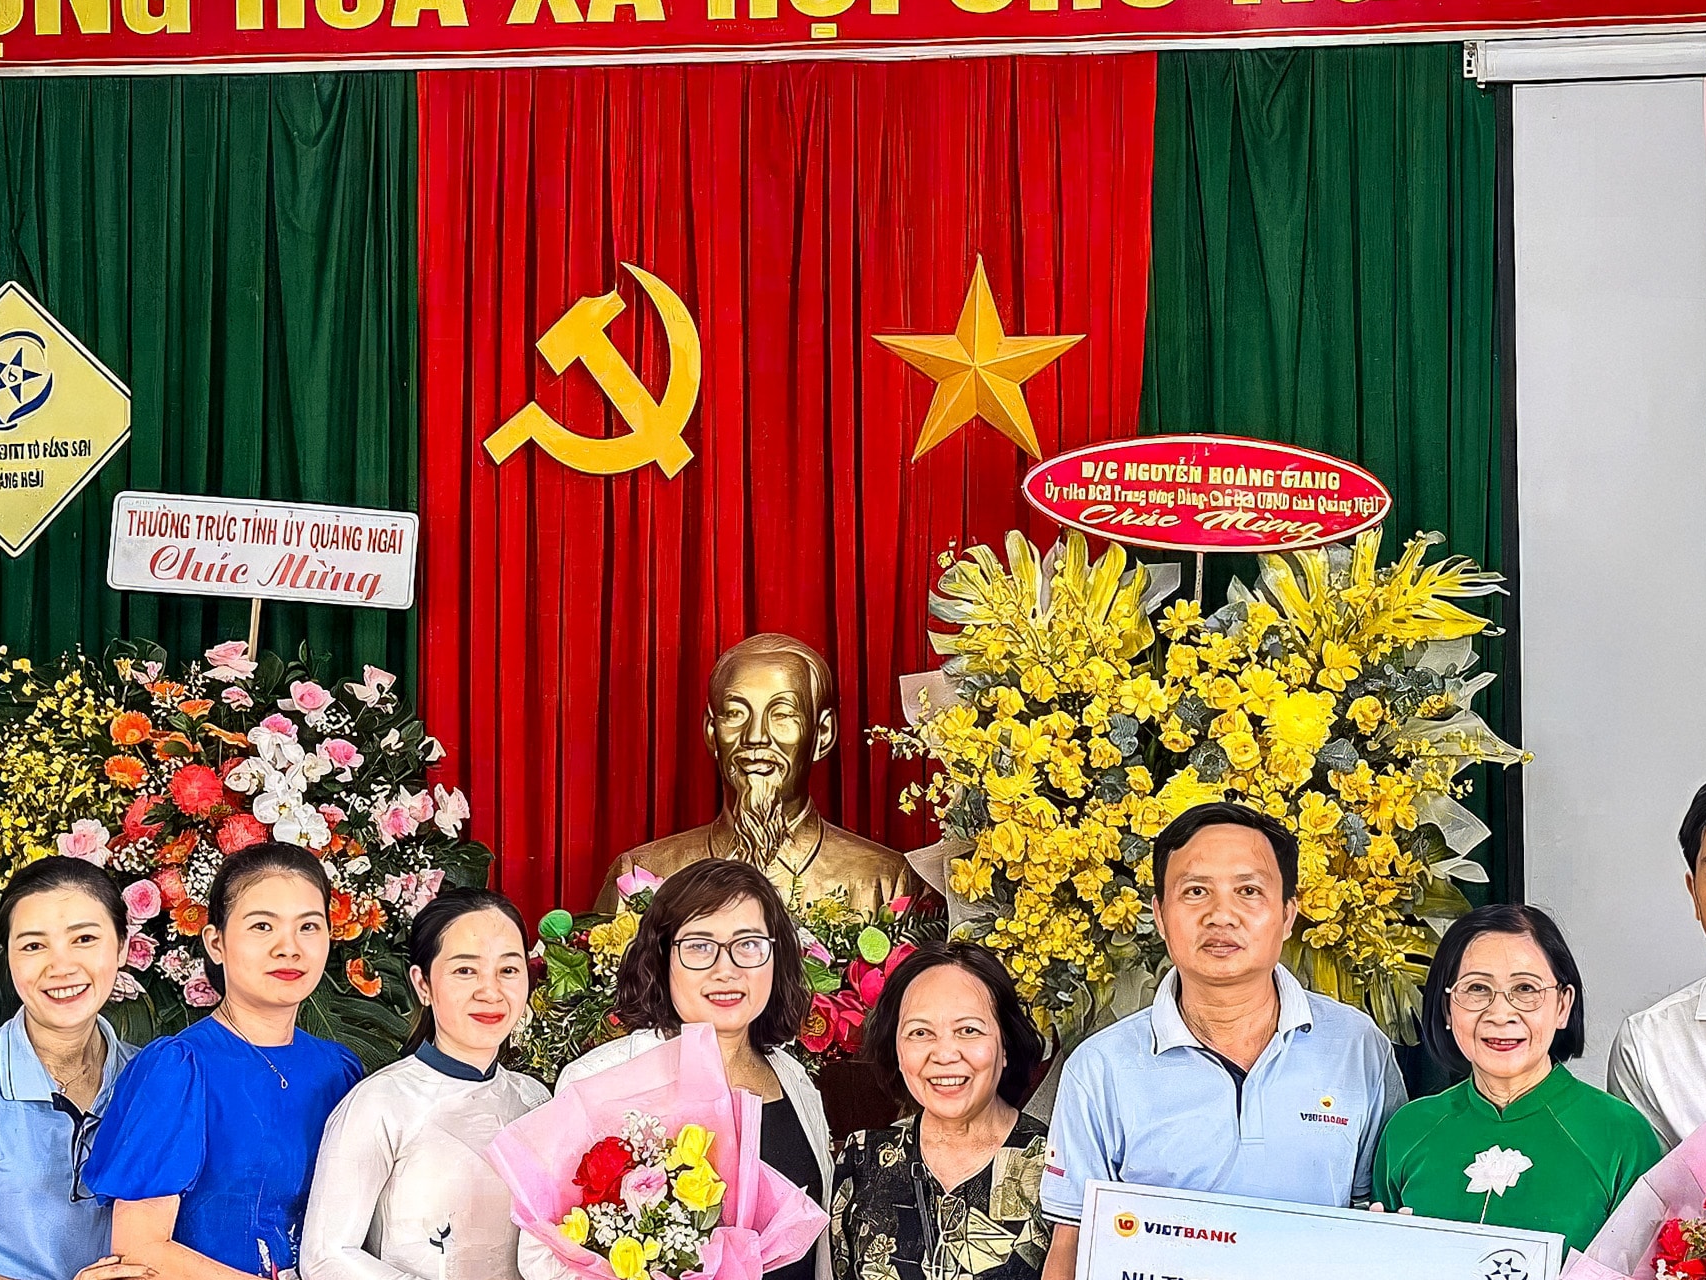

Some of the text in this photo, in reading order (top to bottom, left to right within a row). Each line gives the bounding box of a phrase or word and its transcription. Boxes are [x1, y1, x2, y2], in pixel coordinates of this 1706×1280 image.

[128, 504, 191, 539] THƯỜNG
[196, 510, 237, 547] TRỰC
[242, 508, 277, 546] TỈNH
[367, 523, 404, 555] NGÃI
[149, 545, 384, 601] Chúc Mừng
[1144, 1221, 1237, 1244] VIETBANK
